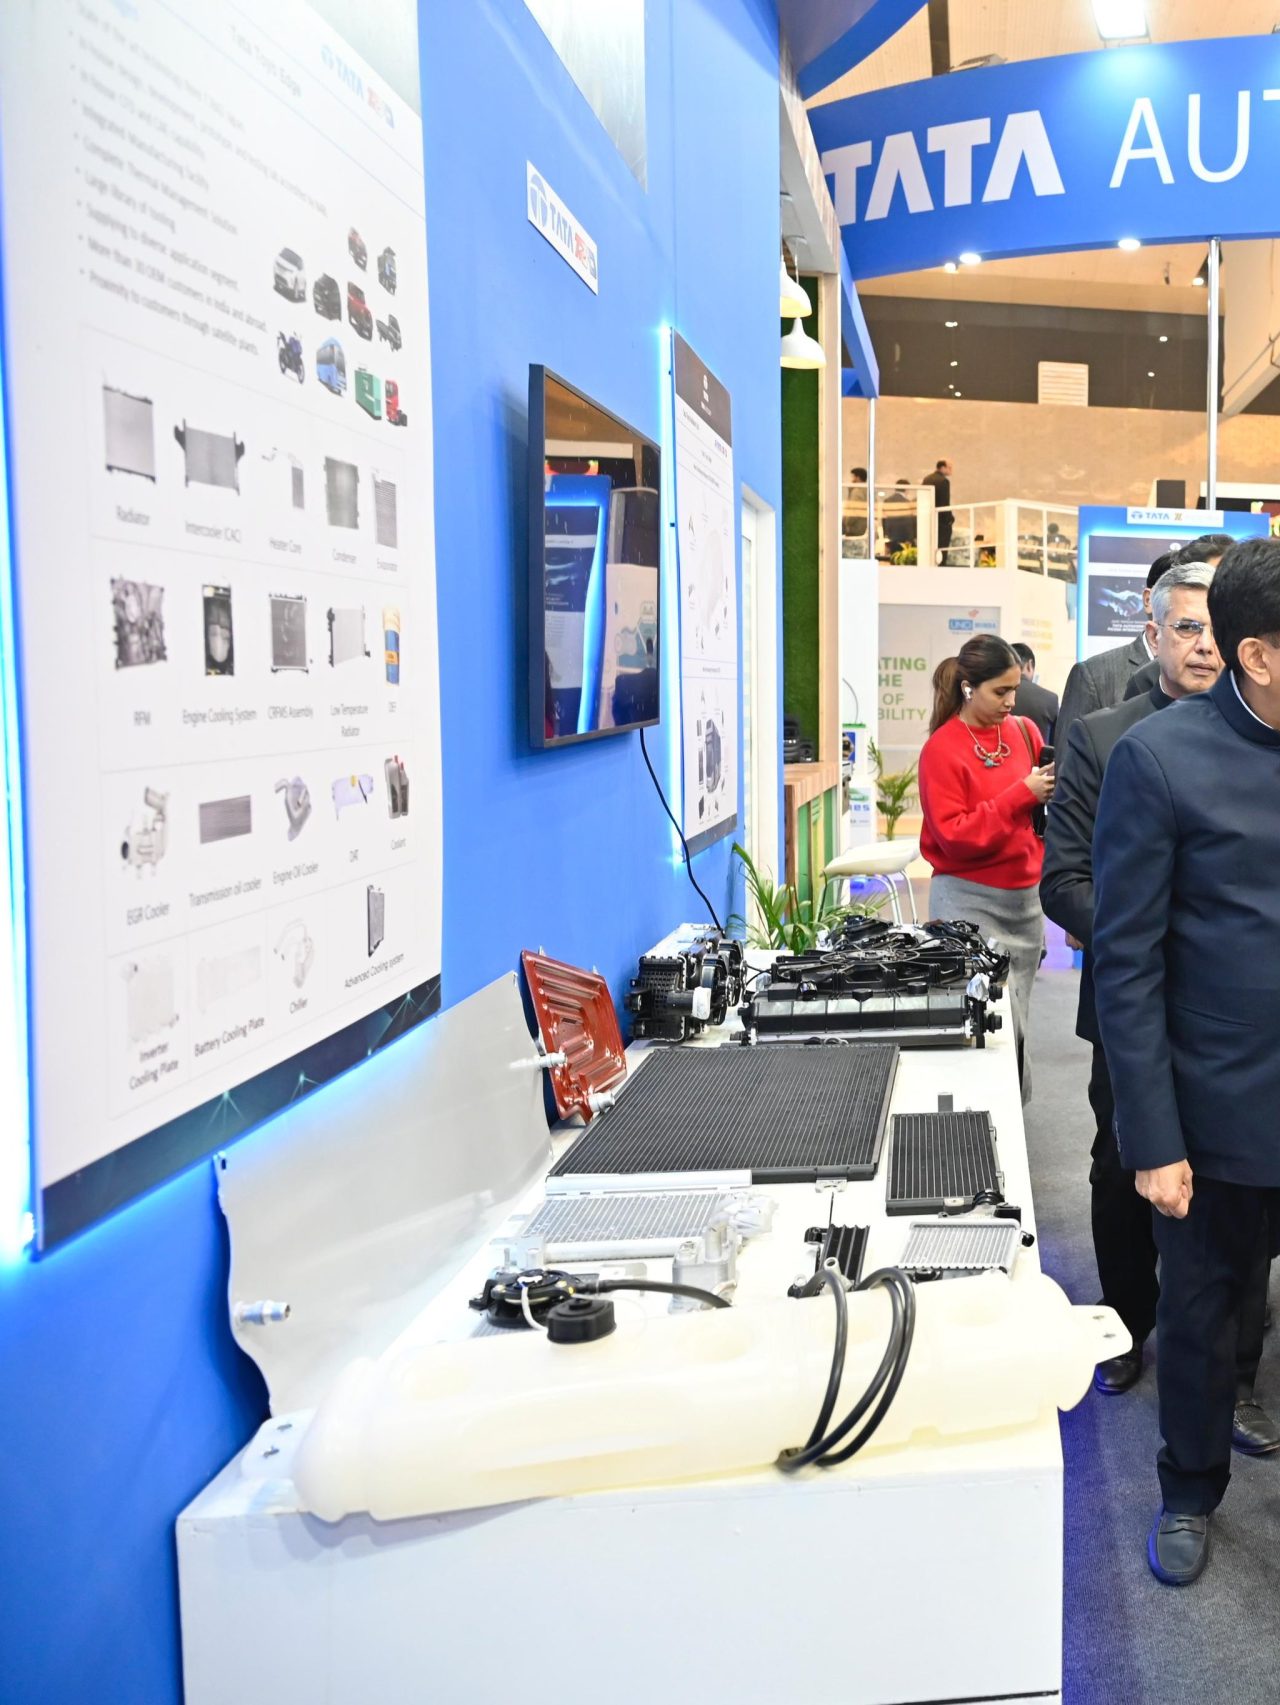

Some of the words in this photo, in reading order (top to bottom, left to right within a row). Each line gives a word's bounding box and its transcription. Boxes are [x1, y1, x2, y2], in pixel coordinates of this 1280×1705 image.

[821, 109, 1066, 226] TATA
[549, 202, 574, 253] TATA
[1145, 512, 1170, 521] TATA
[878, 656, 927, 671] TING
[882, 692, 905, 706] OF
[189, 884, 233, 908] Transmission
[145, 902, 170, 920] Cooler
[289, 997, 308, 1014] Chiller
[194, 1036, 221, 1057] Battery
[222, 1023, 248, 1044] Cooling
[248, 1016, 265, 1031] Plate
[139, 1042, 169, 1063] Inverter
[129, 1067, 159, 1090] Cooling
[160, 1058, 179, 1077] Plate
